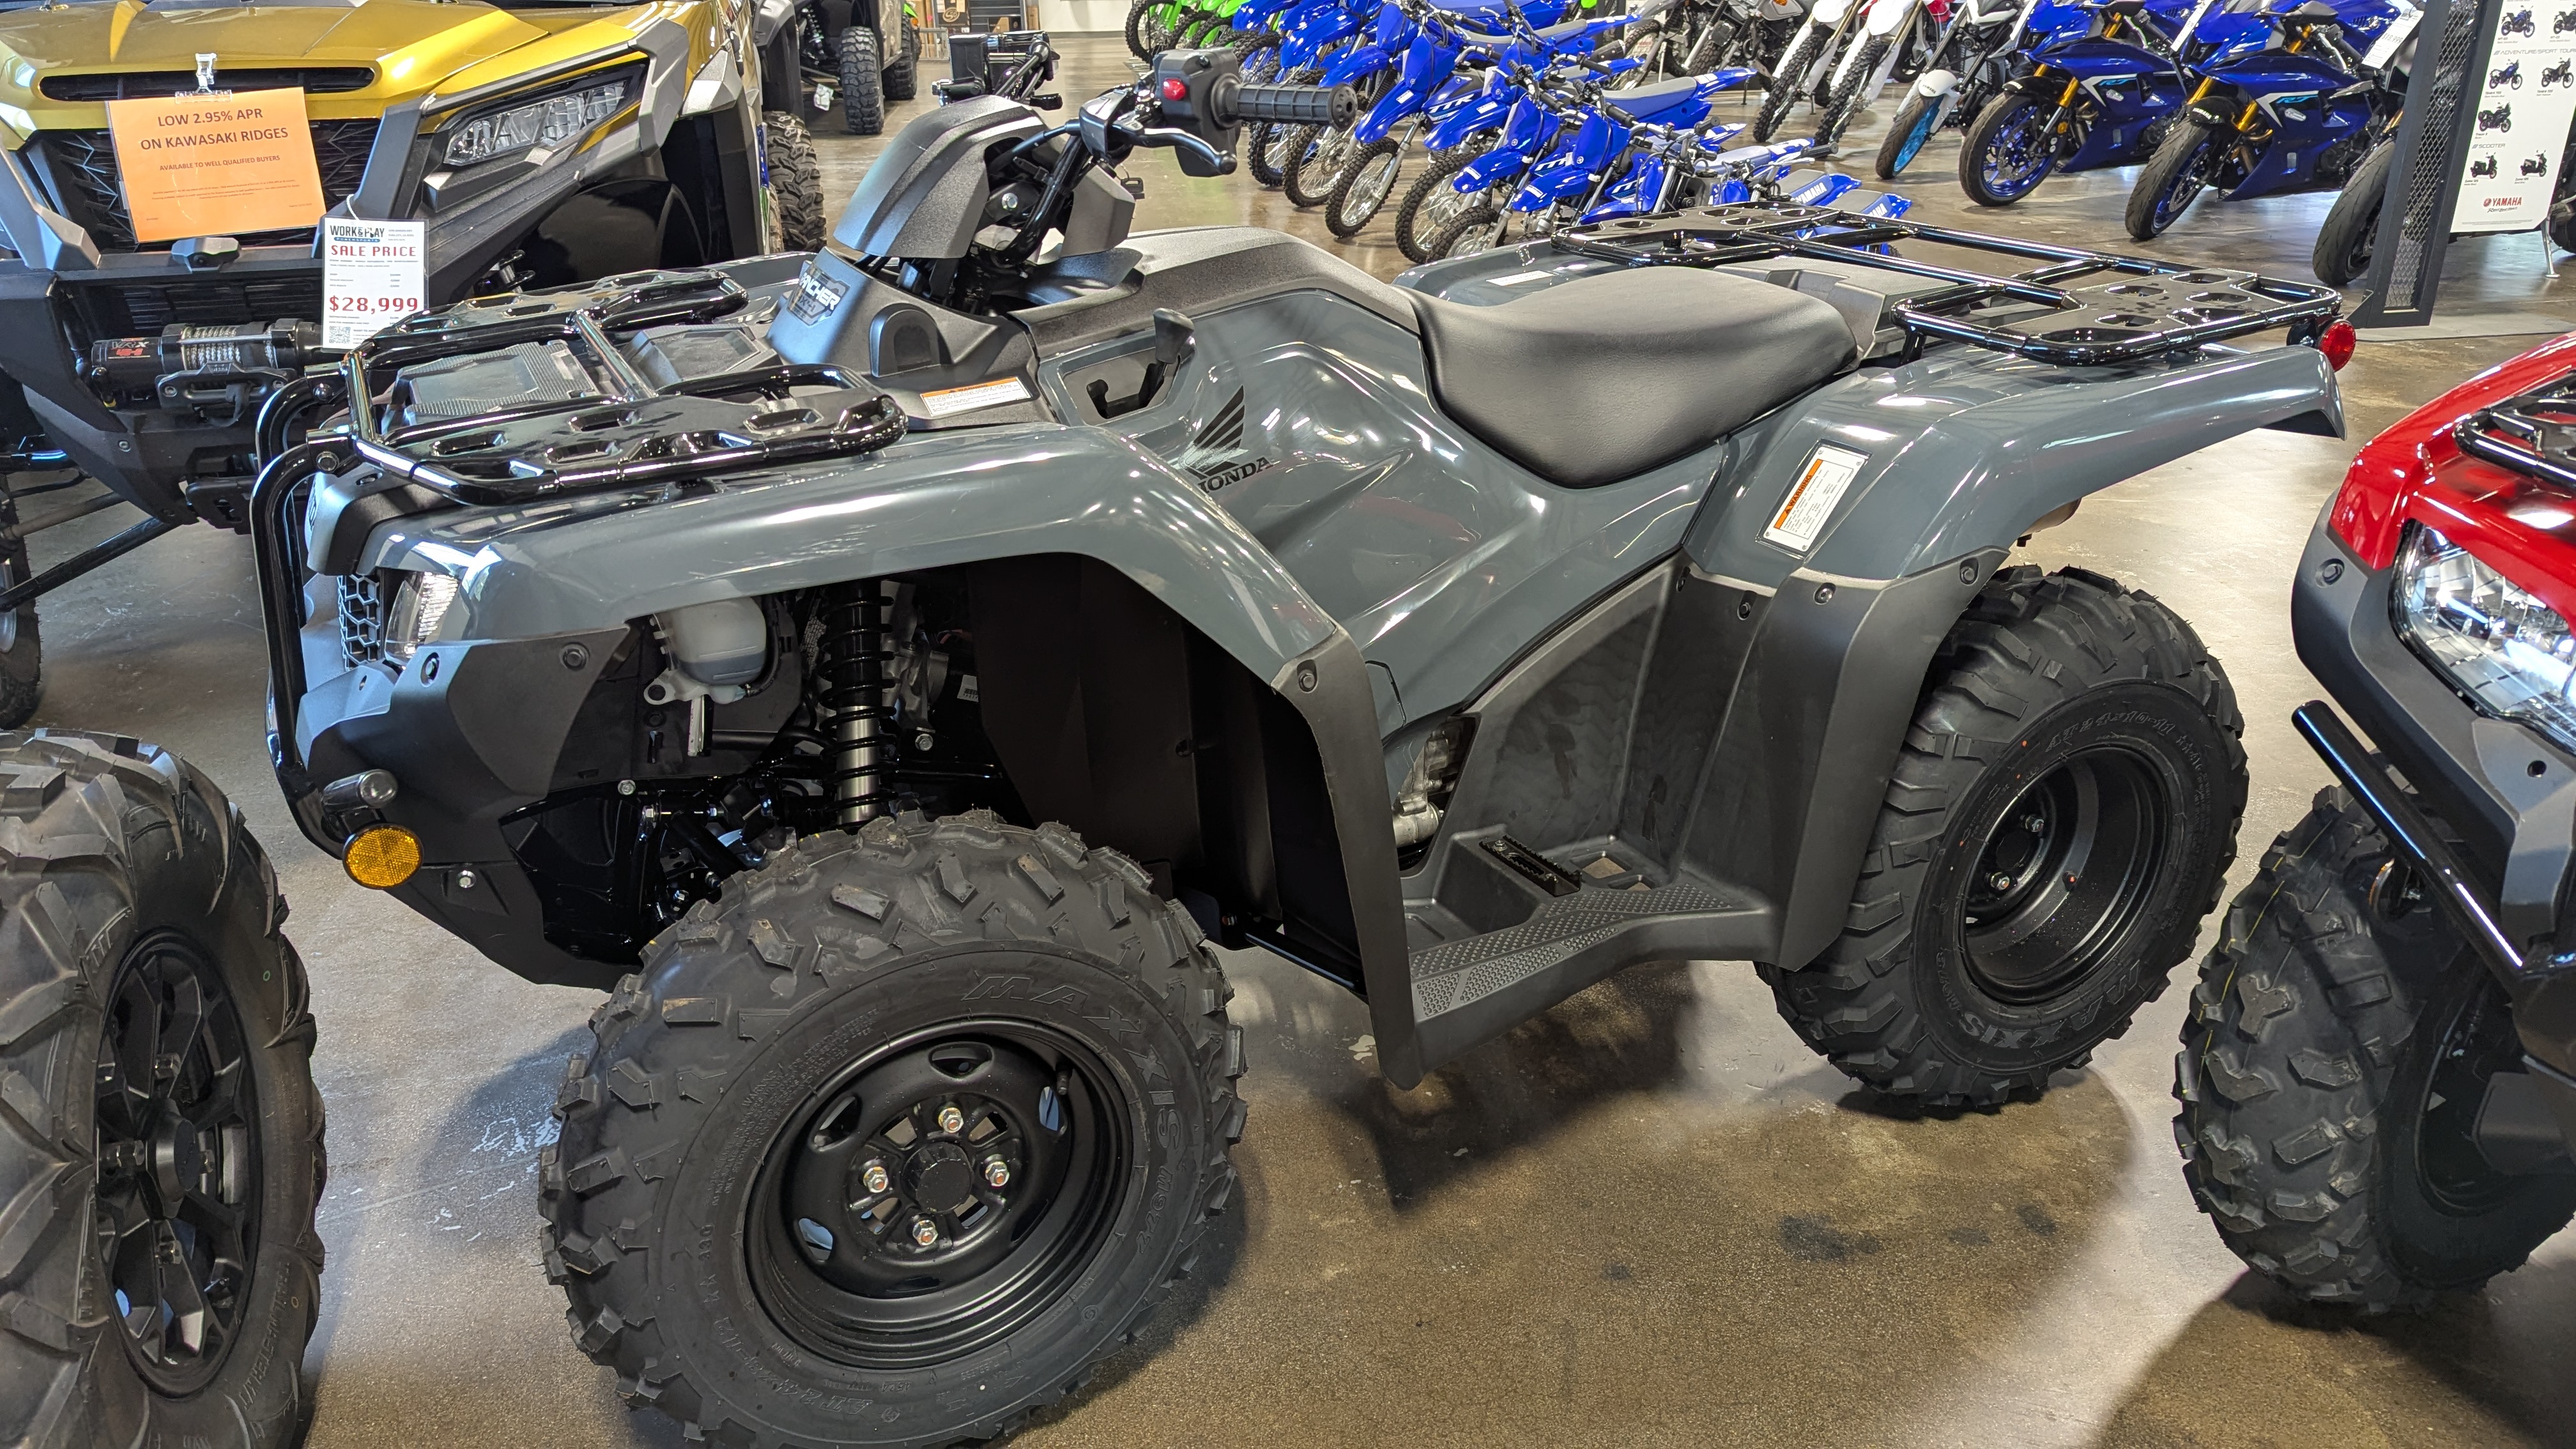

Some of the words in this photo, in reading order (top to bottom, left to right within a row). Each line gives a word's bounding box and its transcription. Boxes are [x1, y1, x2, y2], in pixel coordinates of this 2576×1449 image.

[157, 114, 189, 126] LOW
[192, 110, 233, 124] 2.95%
[236, 108, 263, 120] APR
[2192, 107, 2213, 120] YAMAHA
[141, 139, 162, 151] ON
[166, 132, 238, 149] KAWASAKI
[241, 127, 288, 142] RIDGES
[160, 162, 193, 171] AVAILABLE
[222, 157, 256, 166] QUALIFIED
[256, 155, 280, 163] BUYERS
[1796, 182, 1827, 204] YAMAHA
[2493, 197, 2522, 206] YAMAHA
[331, 245, 366, 257] SALE
[372, 246, 417, 257] PRICE
[329, 295, 418, 314] $28,999
[1789, 475, 1812, 507] WARNING
[1958, 958, 2140, 1049] MAXXIS
[961, 975, 1181, 1150] MAXXIS
